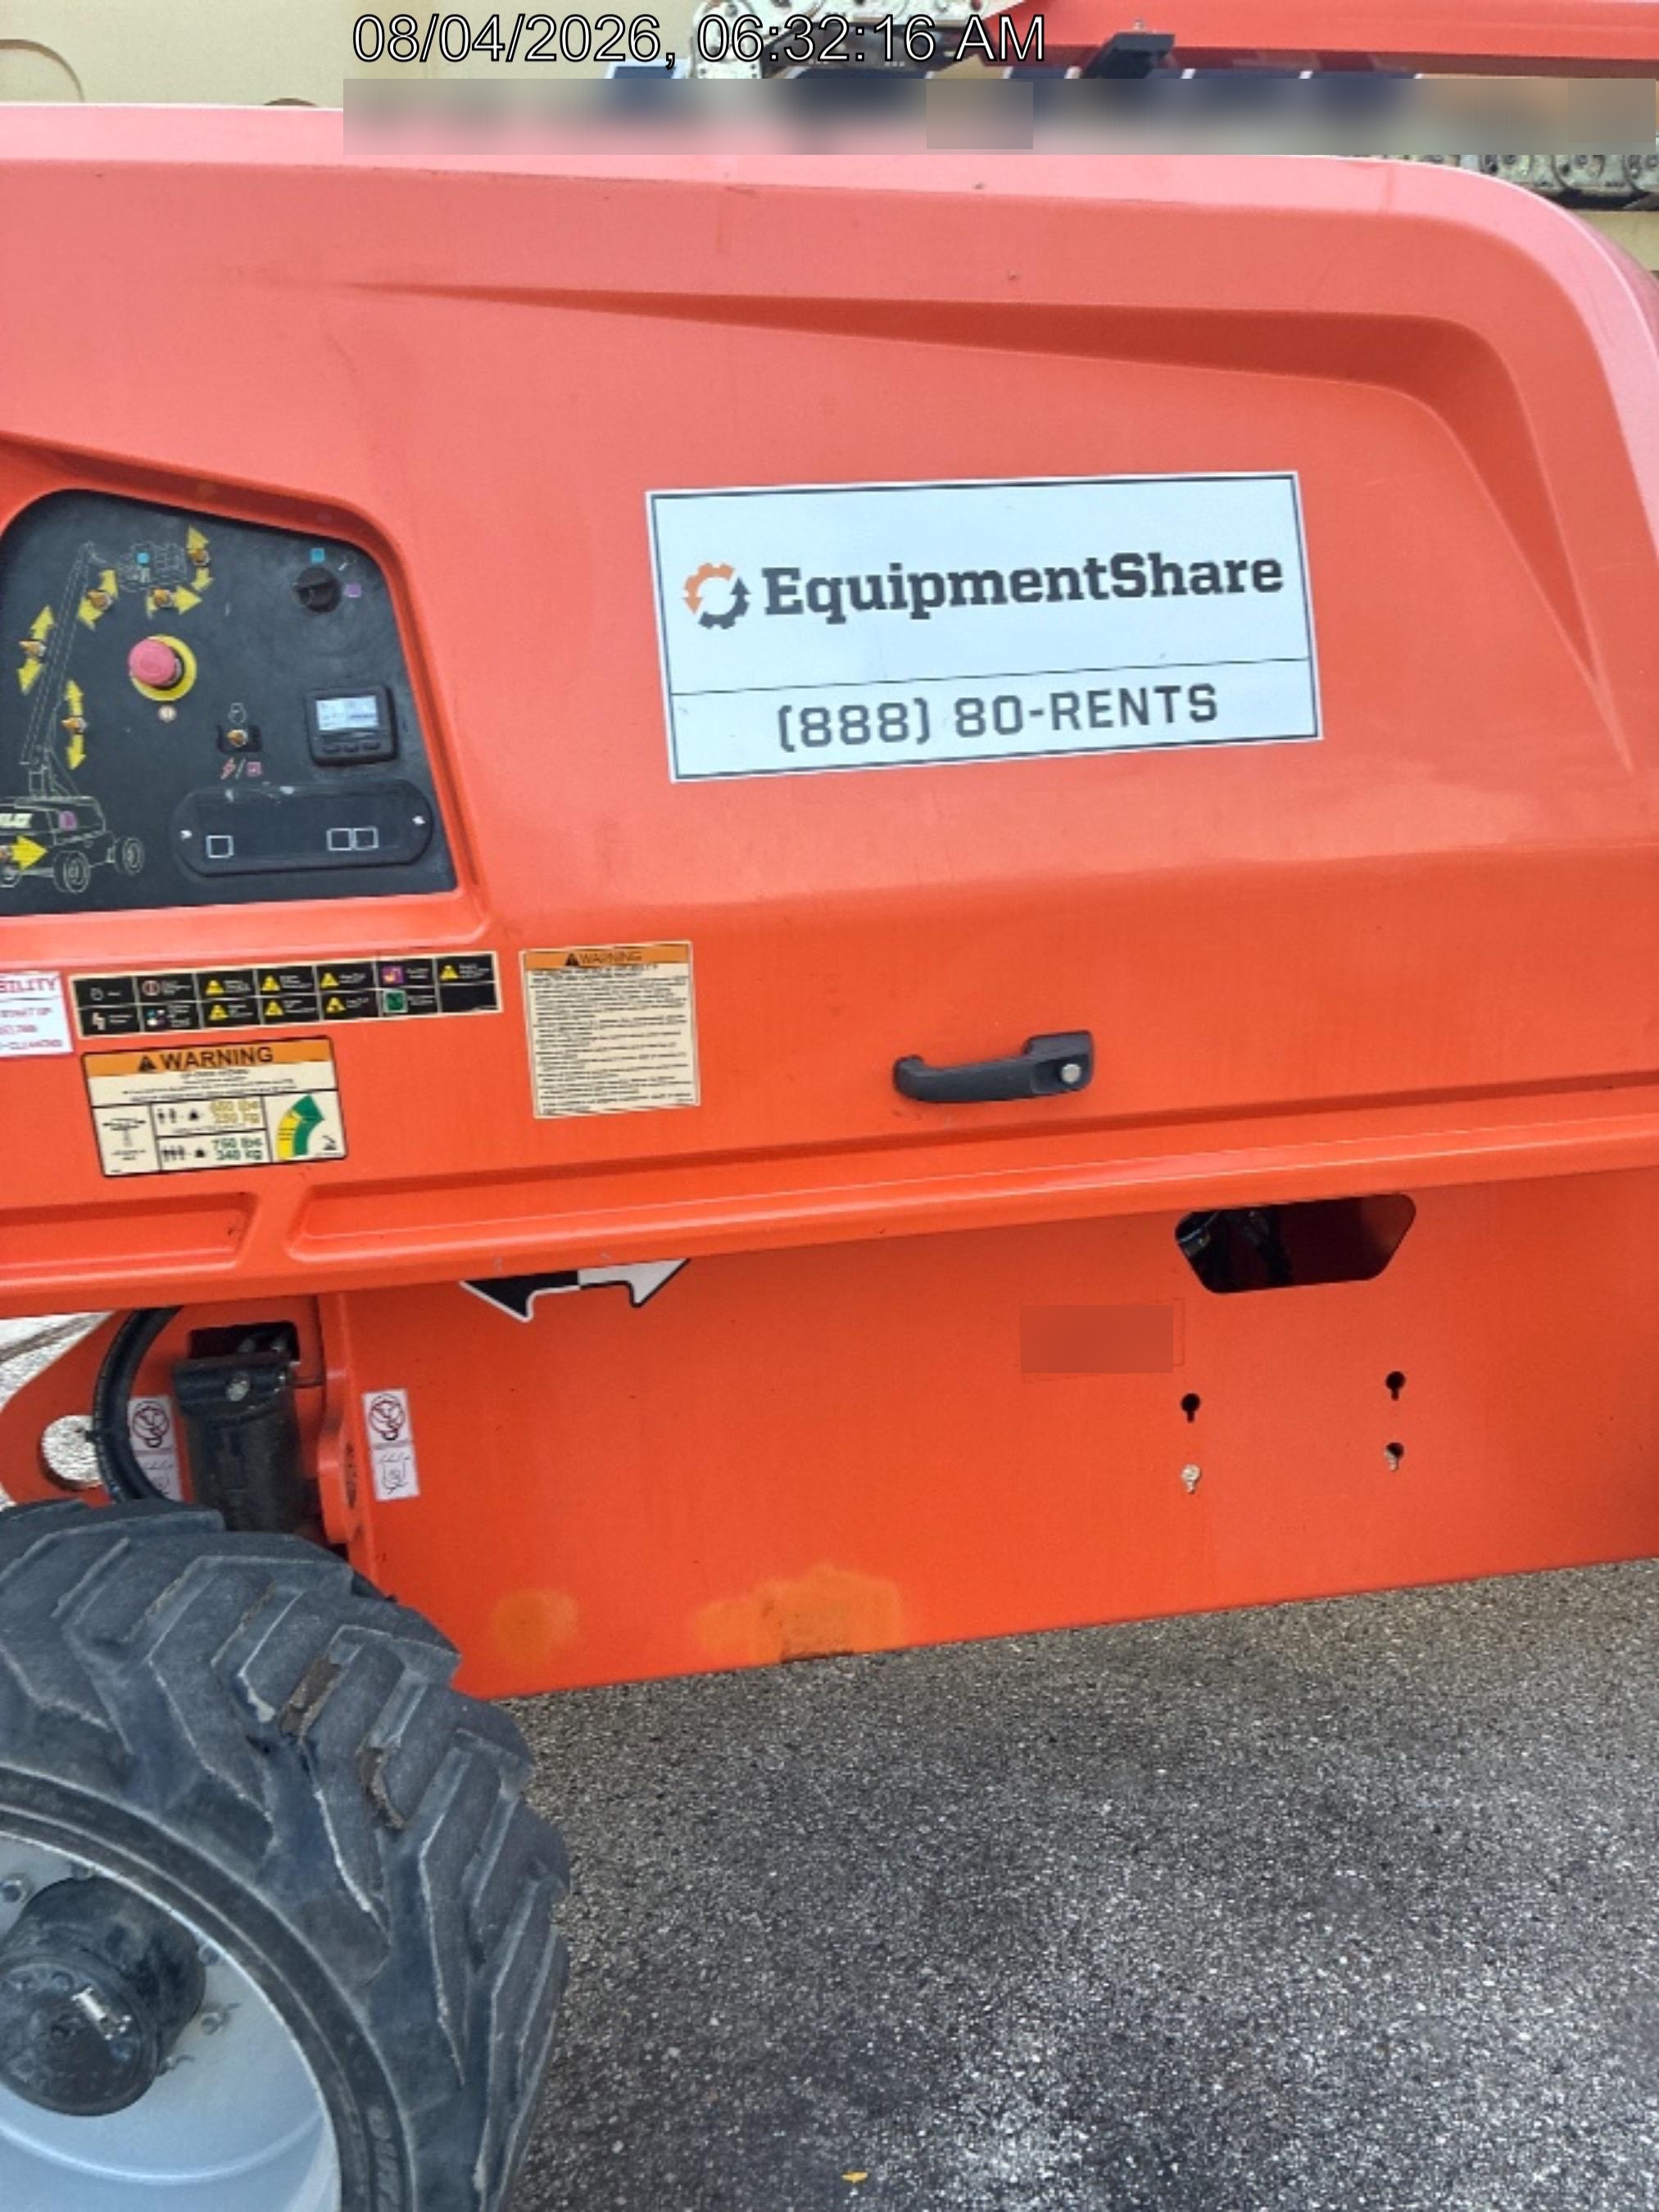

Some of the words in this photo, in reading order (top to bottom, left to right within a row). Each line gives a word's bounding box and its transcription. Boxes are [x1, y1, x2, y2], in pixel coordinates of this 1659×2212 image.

[761, 552, 1284, 624] EquipmentShare
[777, 696, 931, 752] (888)
[954, 682, 1218, 737] 80-RENTS
[578, 950, 642, 965] WARNING
[159, 1045, 274, 1071] WARNING
